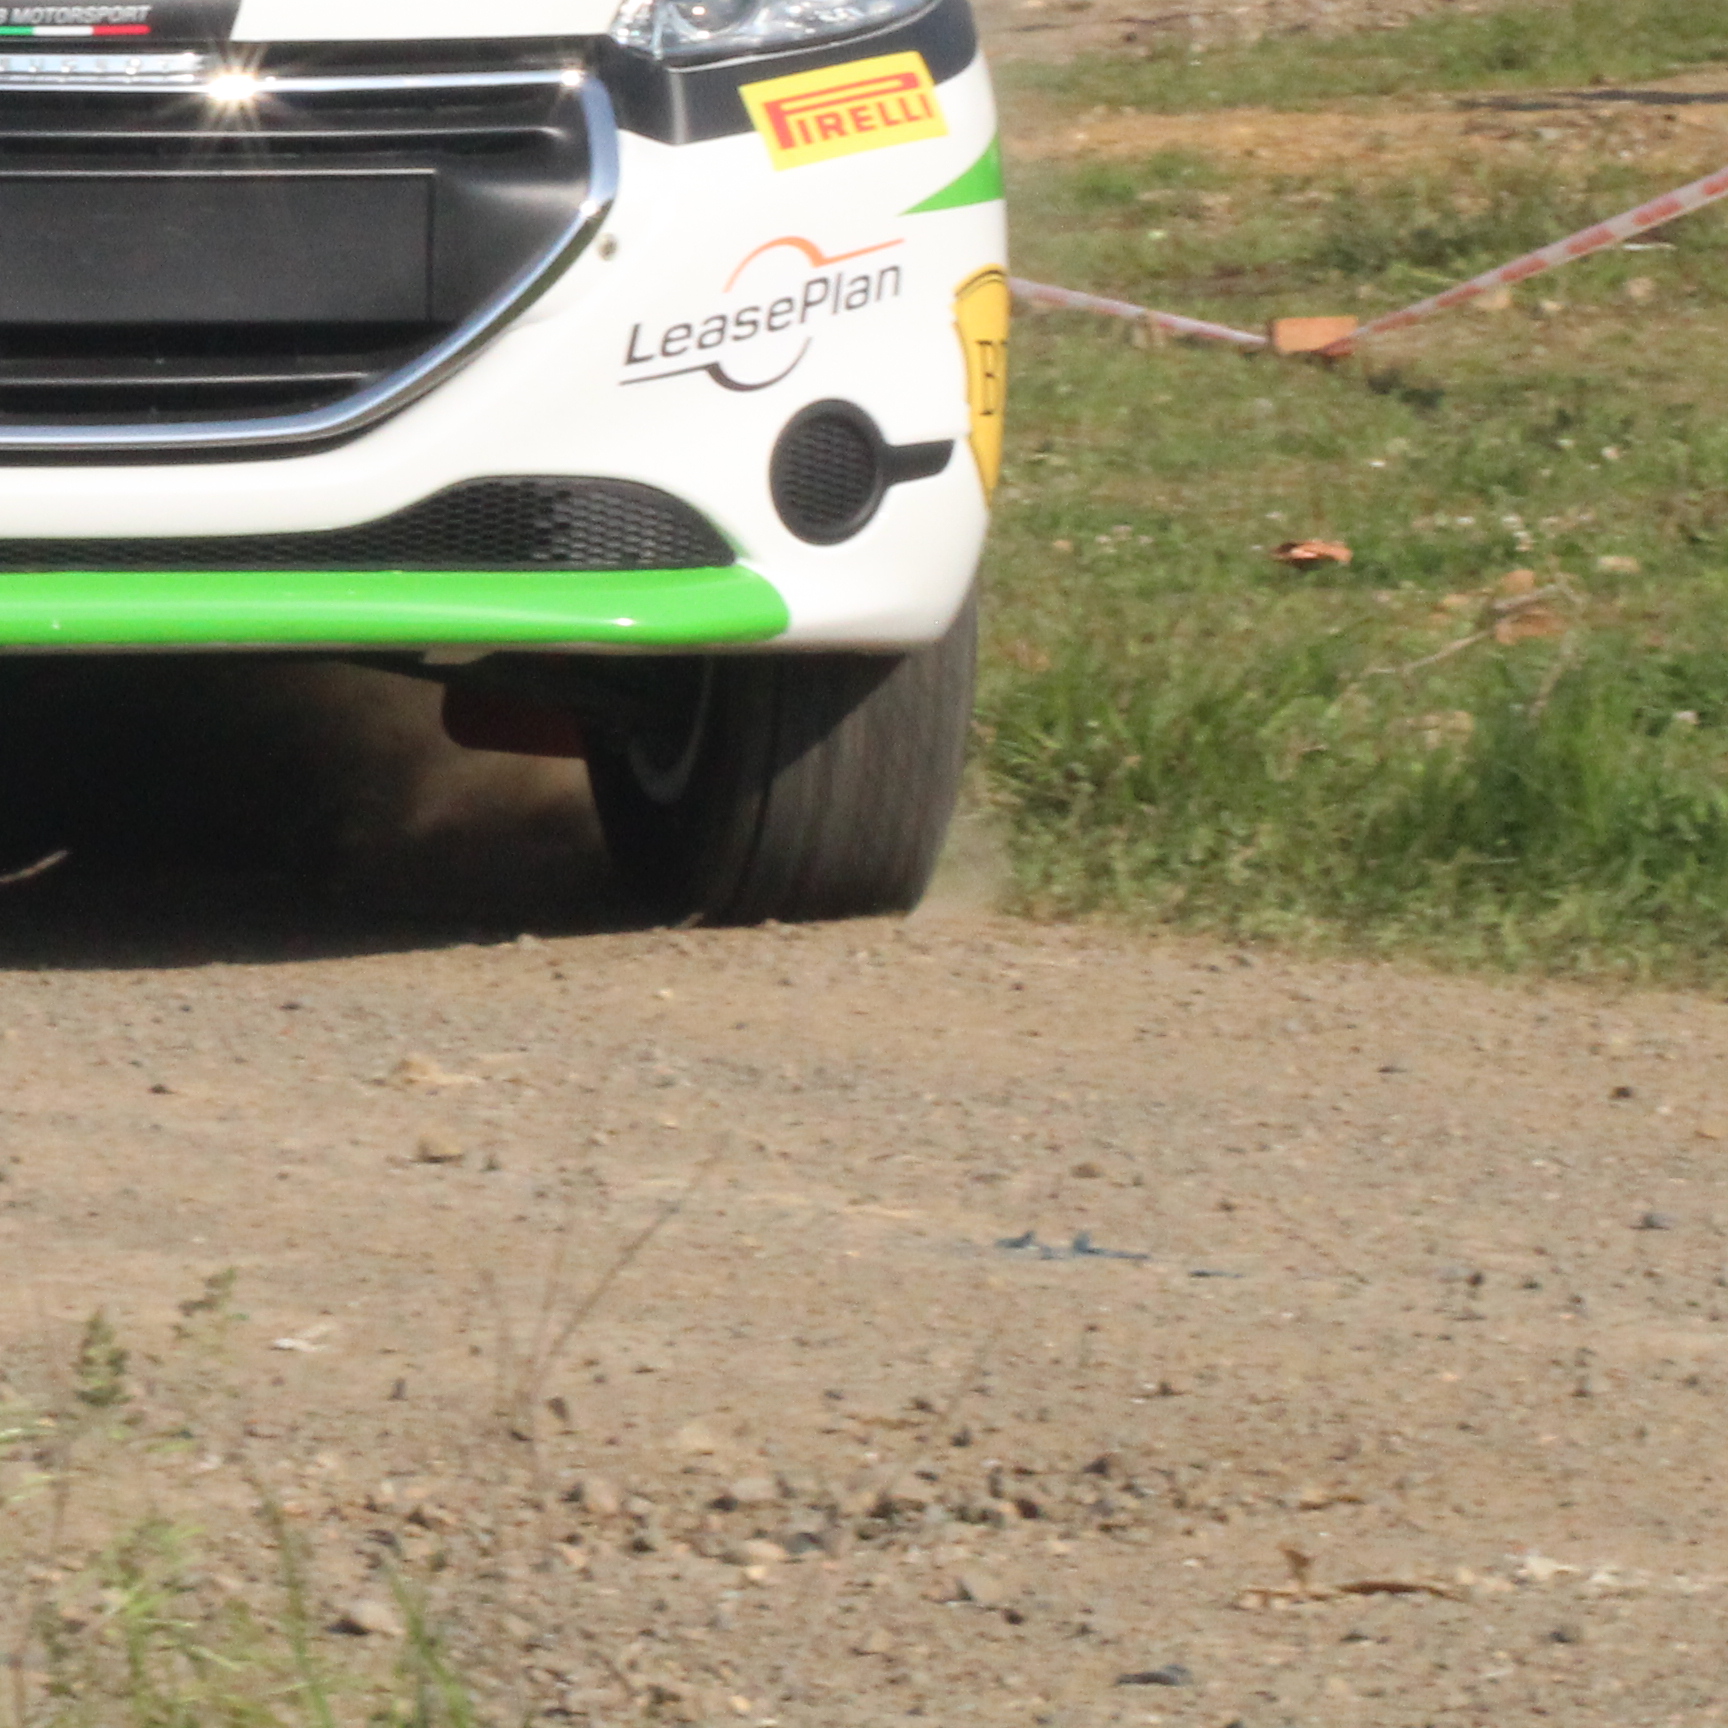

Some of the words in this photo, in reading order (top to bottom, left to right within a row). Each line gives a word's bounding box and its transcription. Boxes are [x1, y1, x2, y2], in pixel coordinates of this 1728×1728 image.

[10, 4, 152, 25] MOTORSPORT
[763, 71, 935, 150] PIRELLI
[624, 264, 902, 367] LeasePlan
